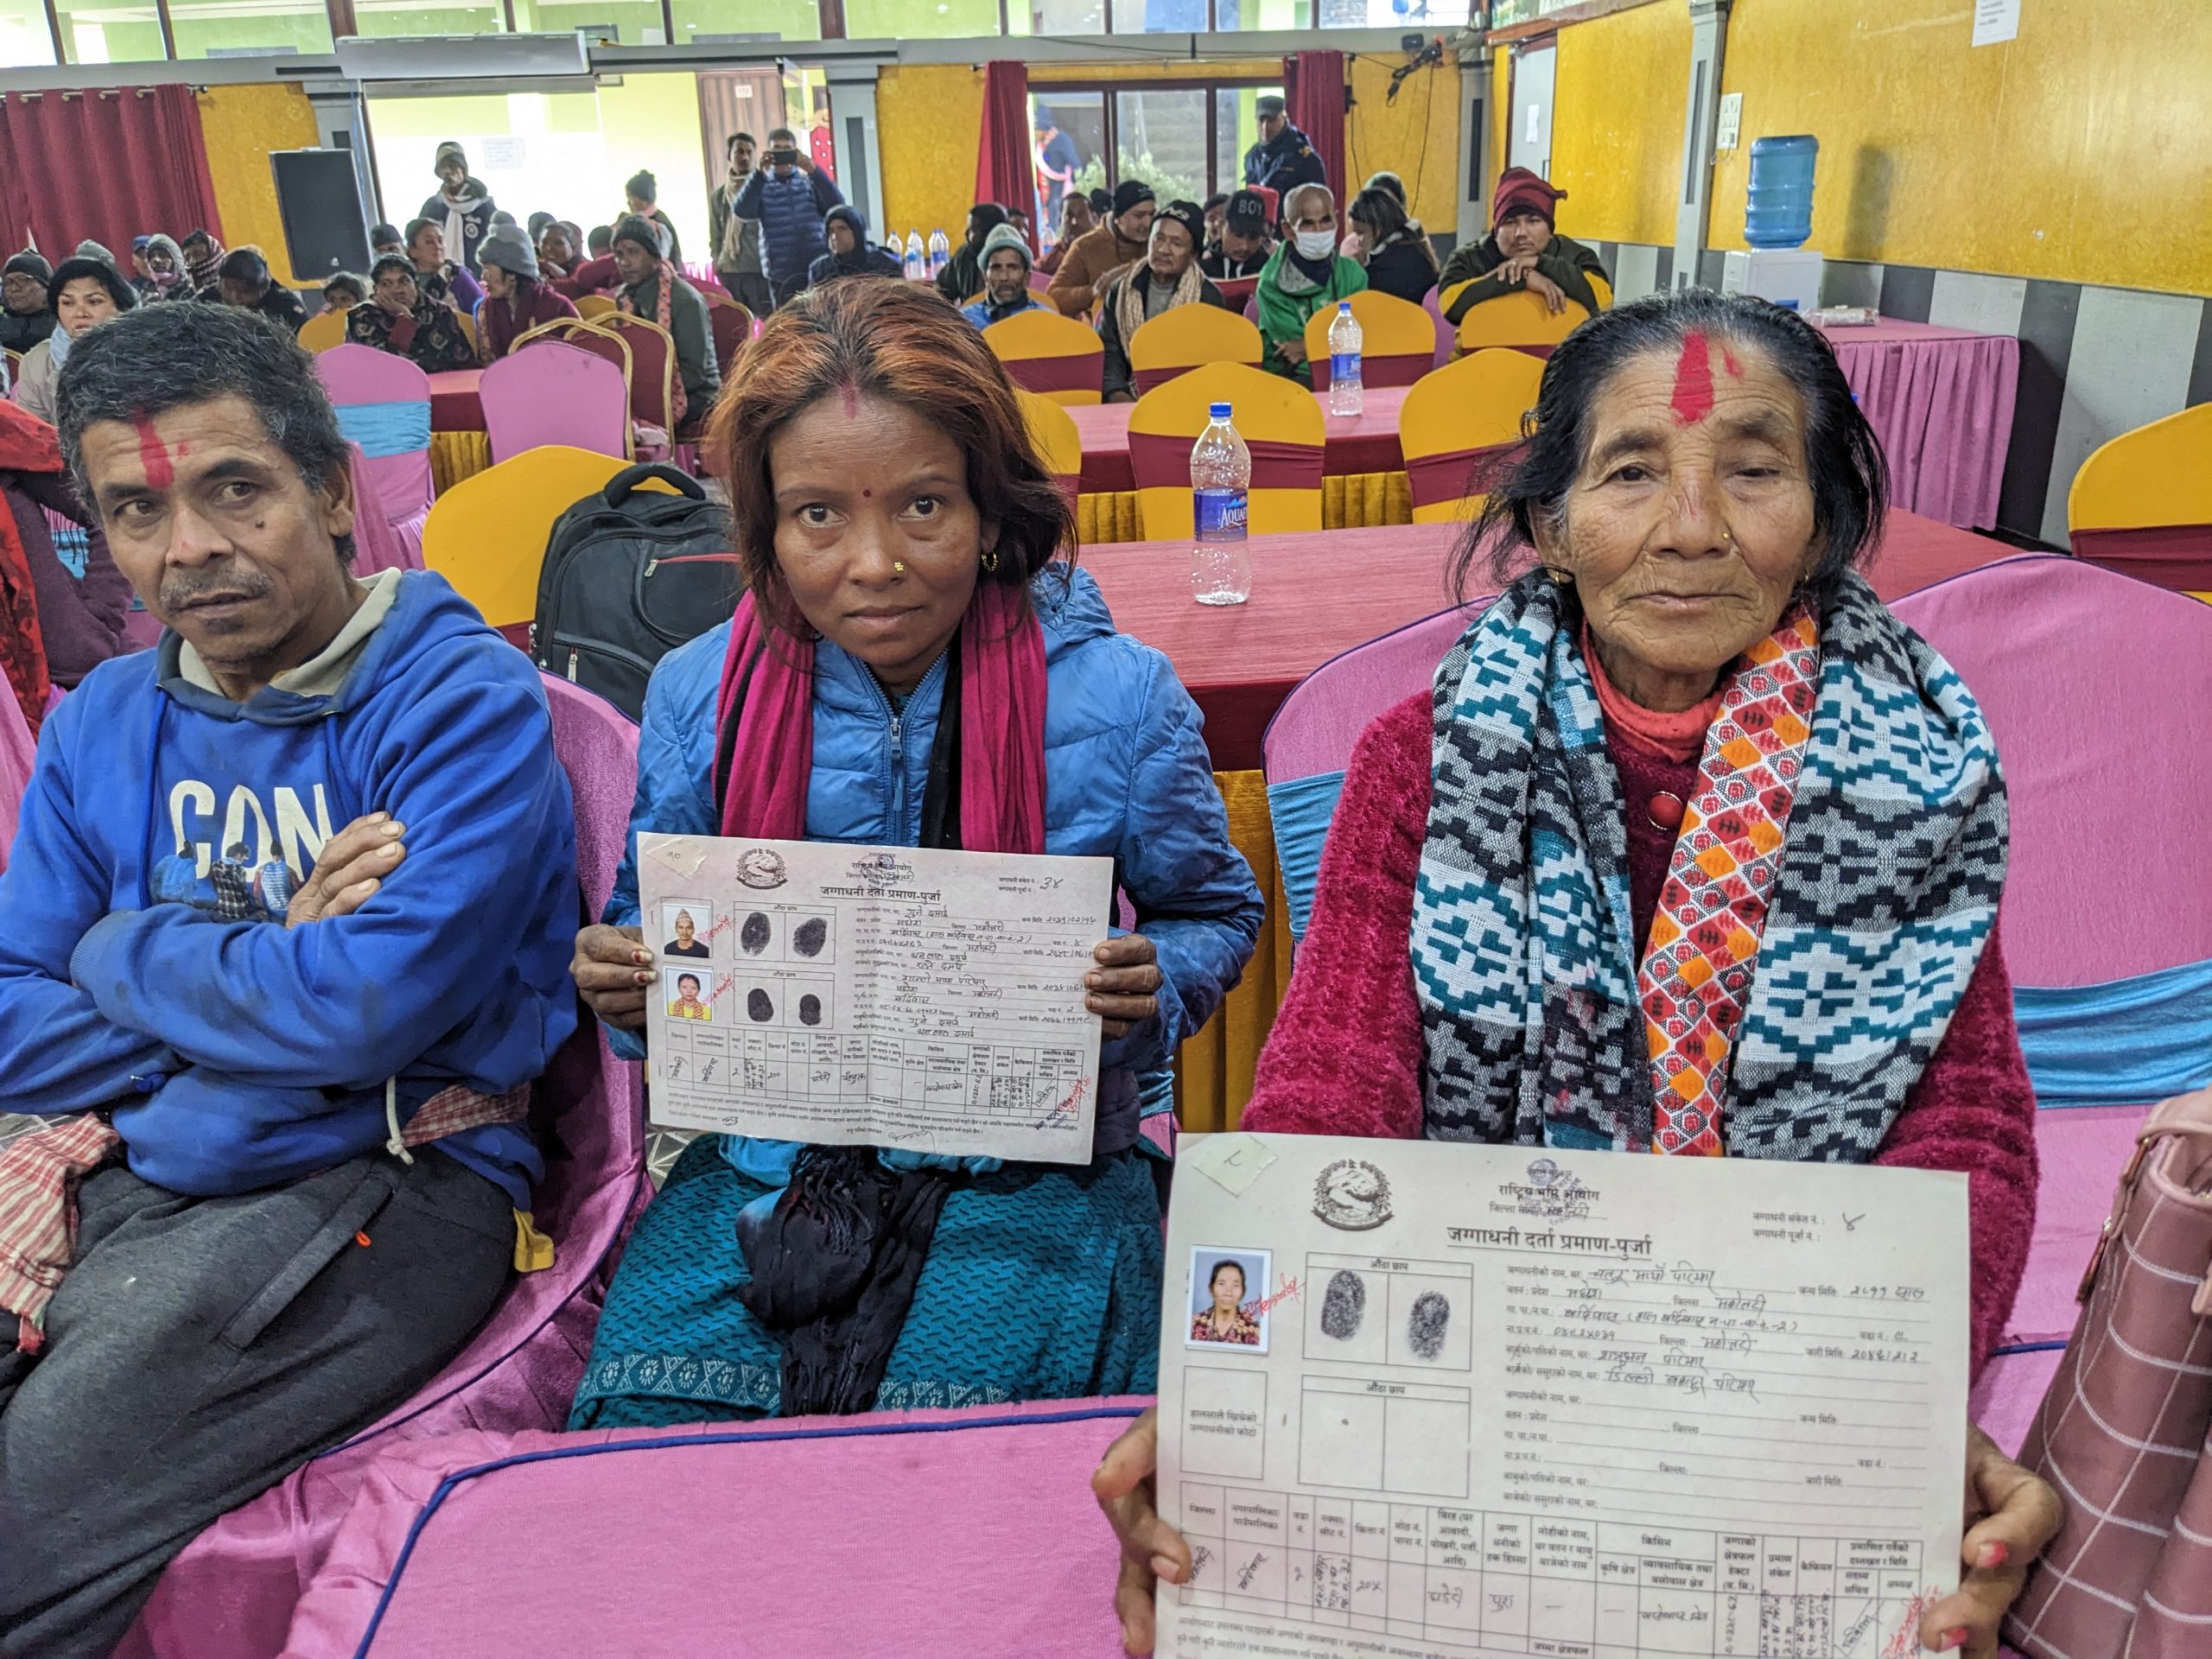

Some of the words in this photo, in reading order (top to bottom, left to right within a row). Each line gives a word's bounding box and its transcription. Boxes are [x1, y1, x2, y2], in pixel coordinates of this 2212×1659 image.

[1238, 199, 1263, 215] BOY
[820, 886, 864, 897] जग्गाधनी
[887, 889, 941, 905] प्रमाण-पुर्जा
[1447, 1225, 1519, 1245] जग्गाधनी
[1524, 1229, 1556, 1249] दर्ता
[1560, 1234, 1653, 1260] प्रमाण-पुर्जा
[1392, 1262, 1408, 1270] छाप
[1389, 1384, 1406, 1395] छाप
